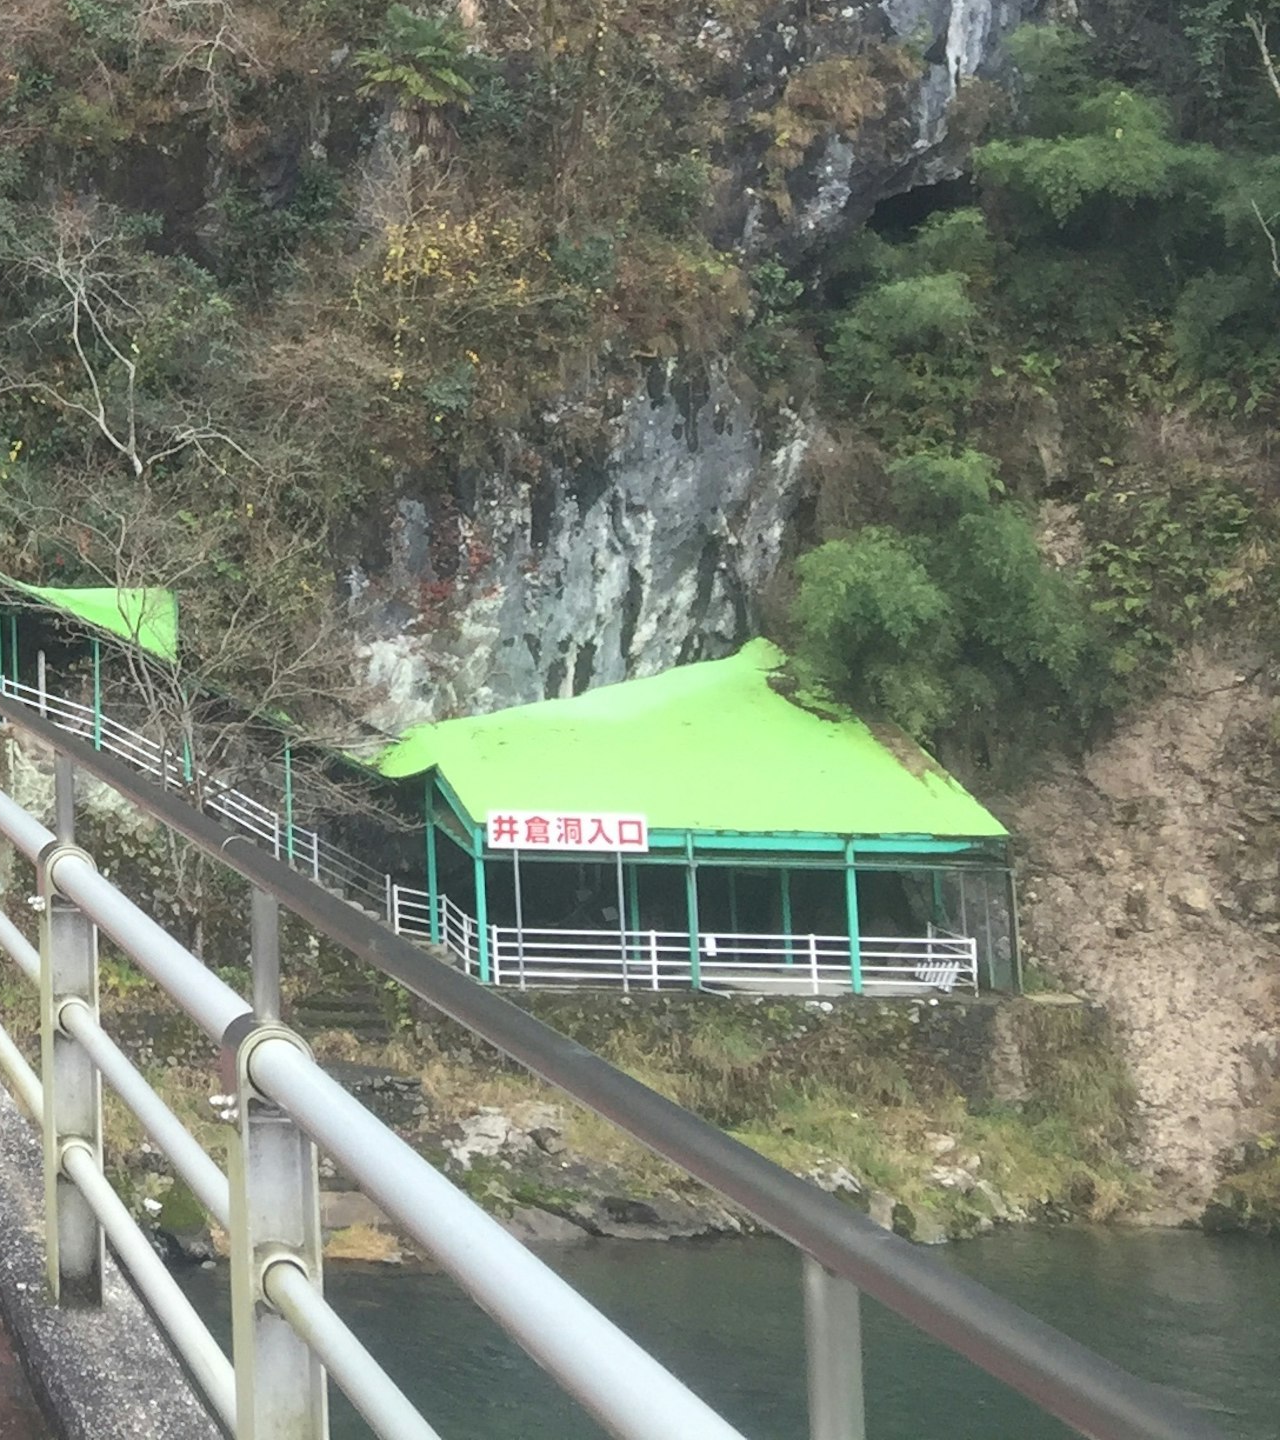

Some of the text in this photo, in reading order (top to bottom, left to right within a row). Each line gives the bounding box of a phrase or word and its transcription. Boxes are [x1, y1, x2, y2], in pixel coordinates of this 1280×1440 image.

[493, 815, 643, 845] 井倉洞入口
